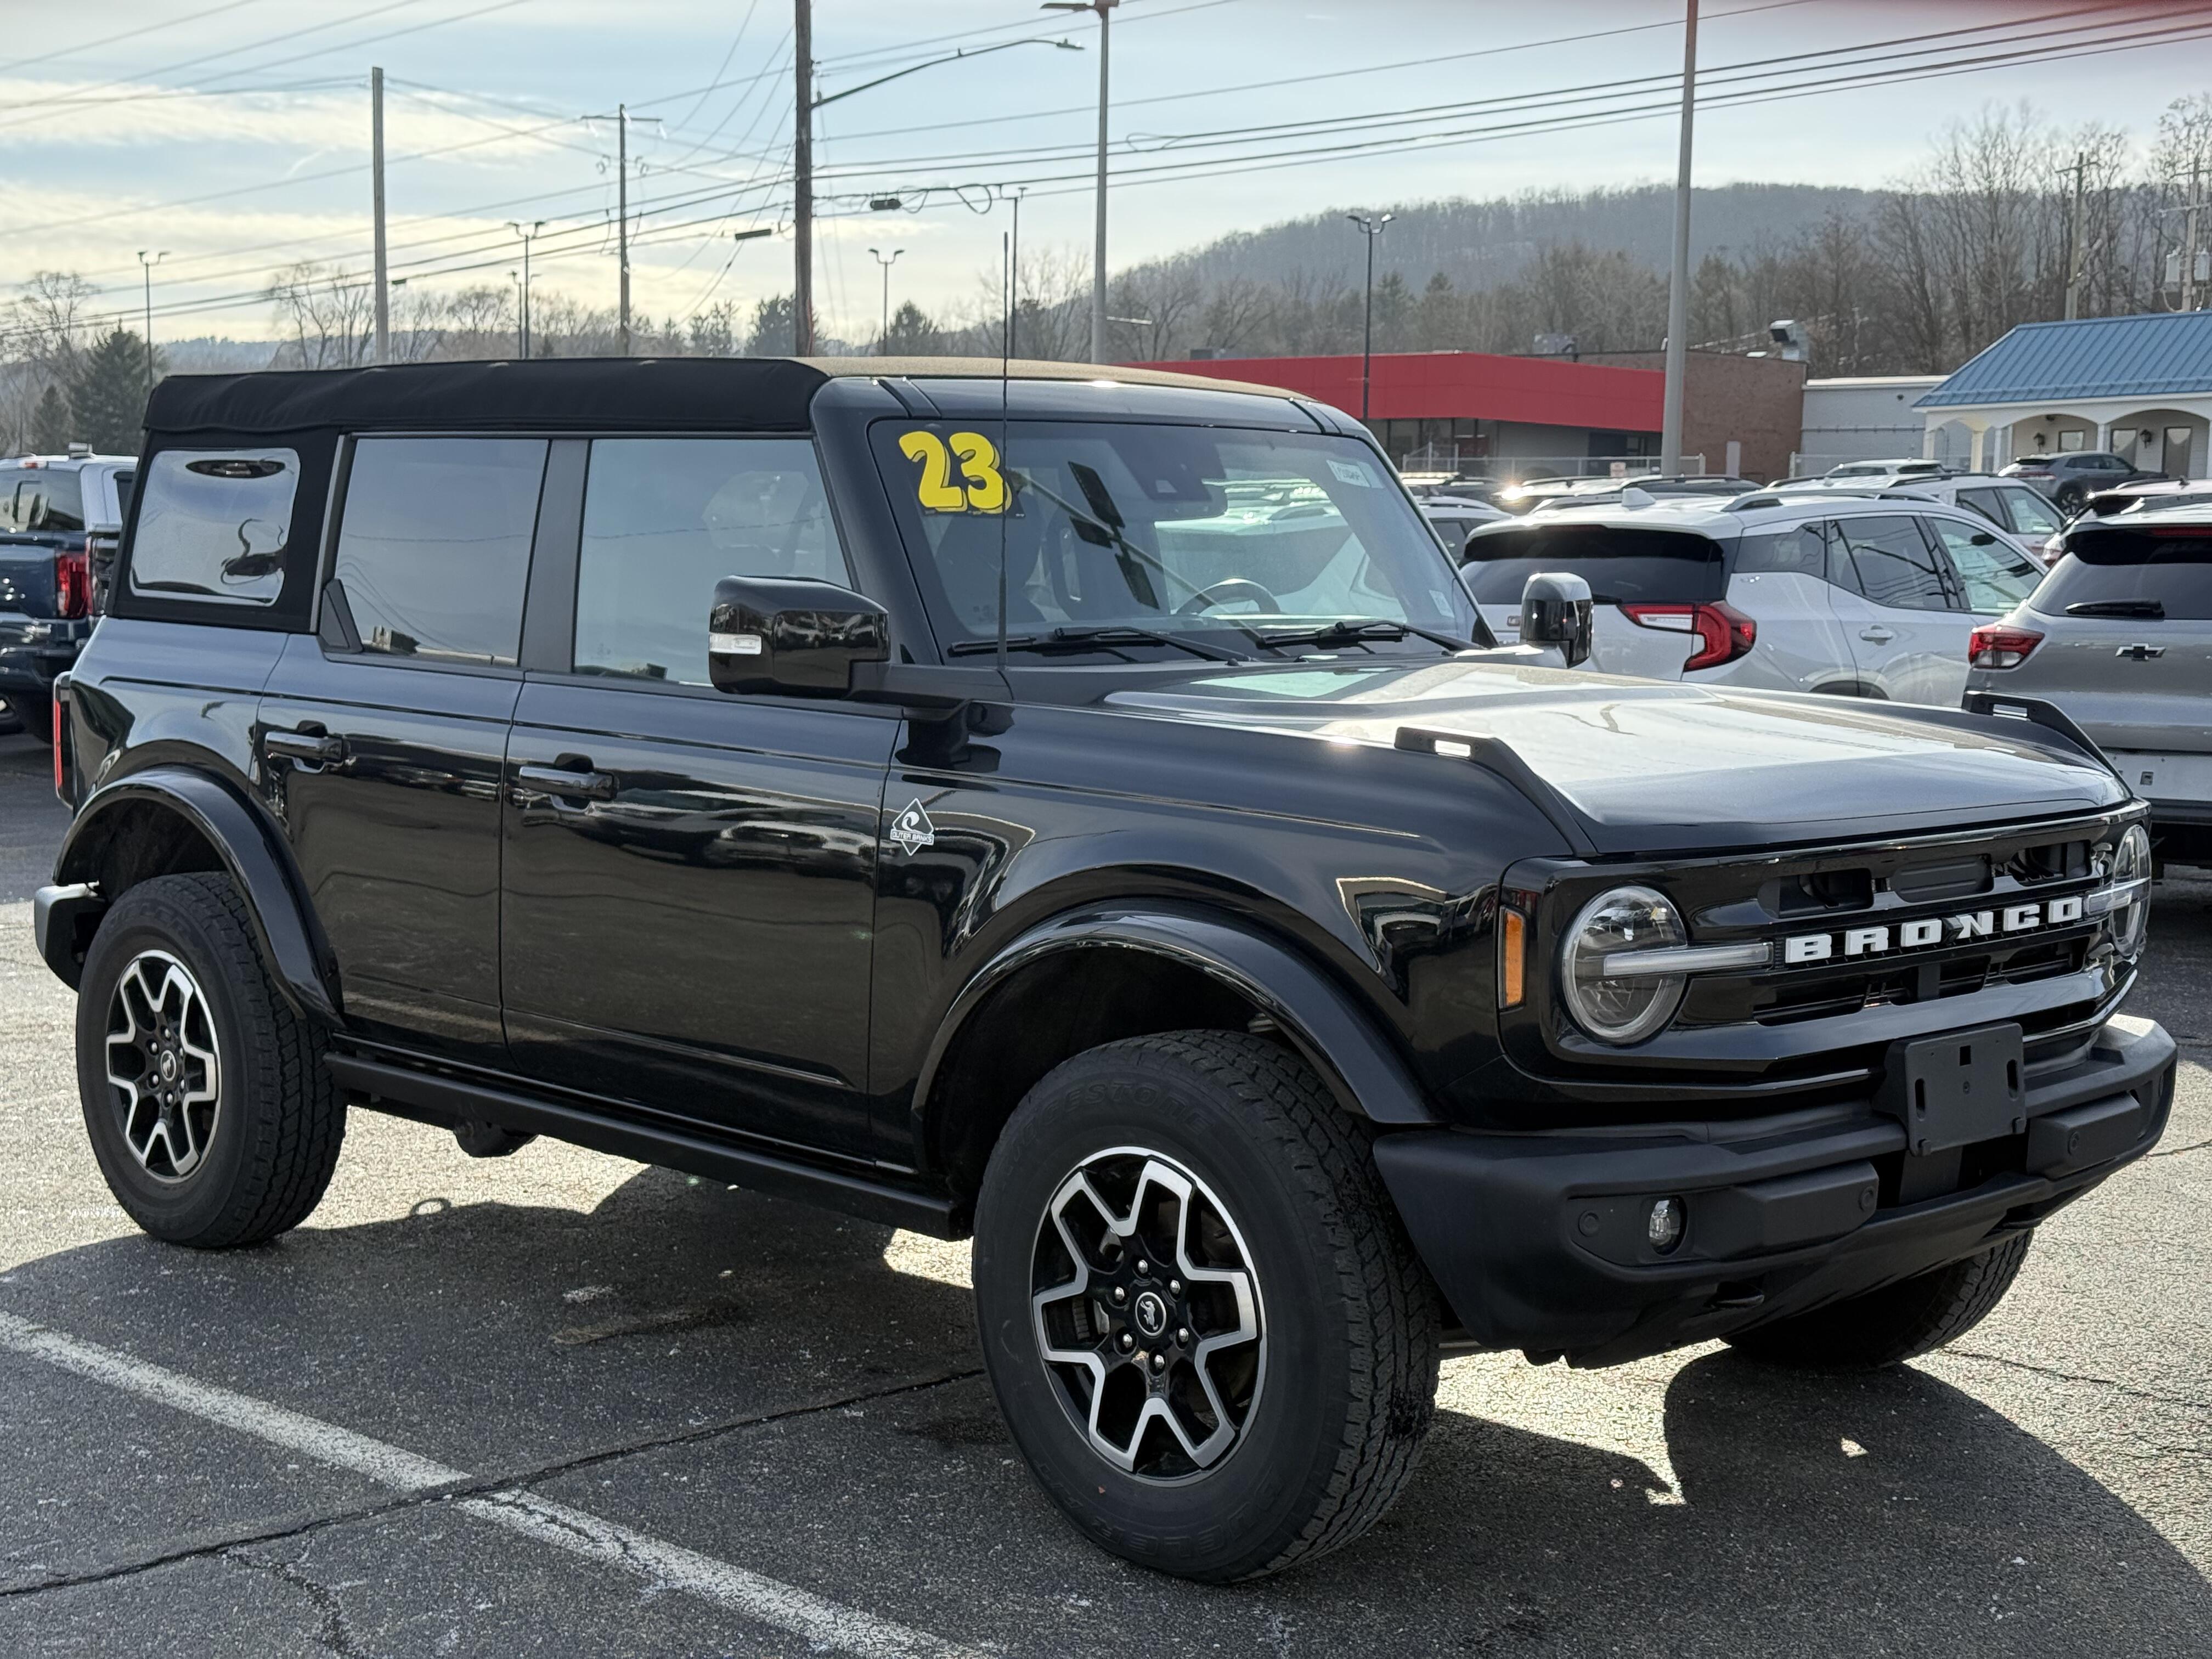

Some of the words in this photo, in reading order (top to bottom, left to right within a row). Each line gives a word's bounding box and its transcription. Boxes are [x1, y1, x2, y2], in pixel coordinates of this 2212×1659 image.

[899, 431, 1012, 514] 23
[892, 831, 911, 840] OUTER
[912, 834, 932, 843] BANKS
[1785, 896, 2082, 963] BRONCO
